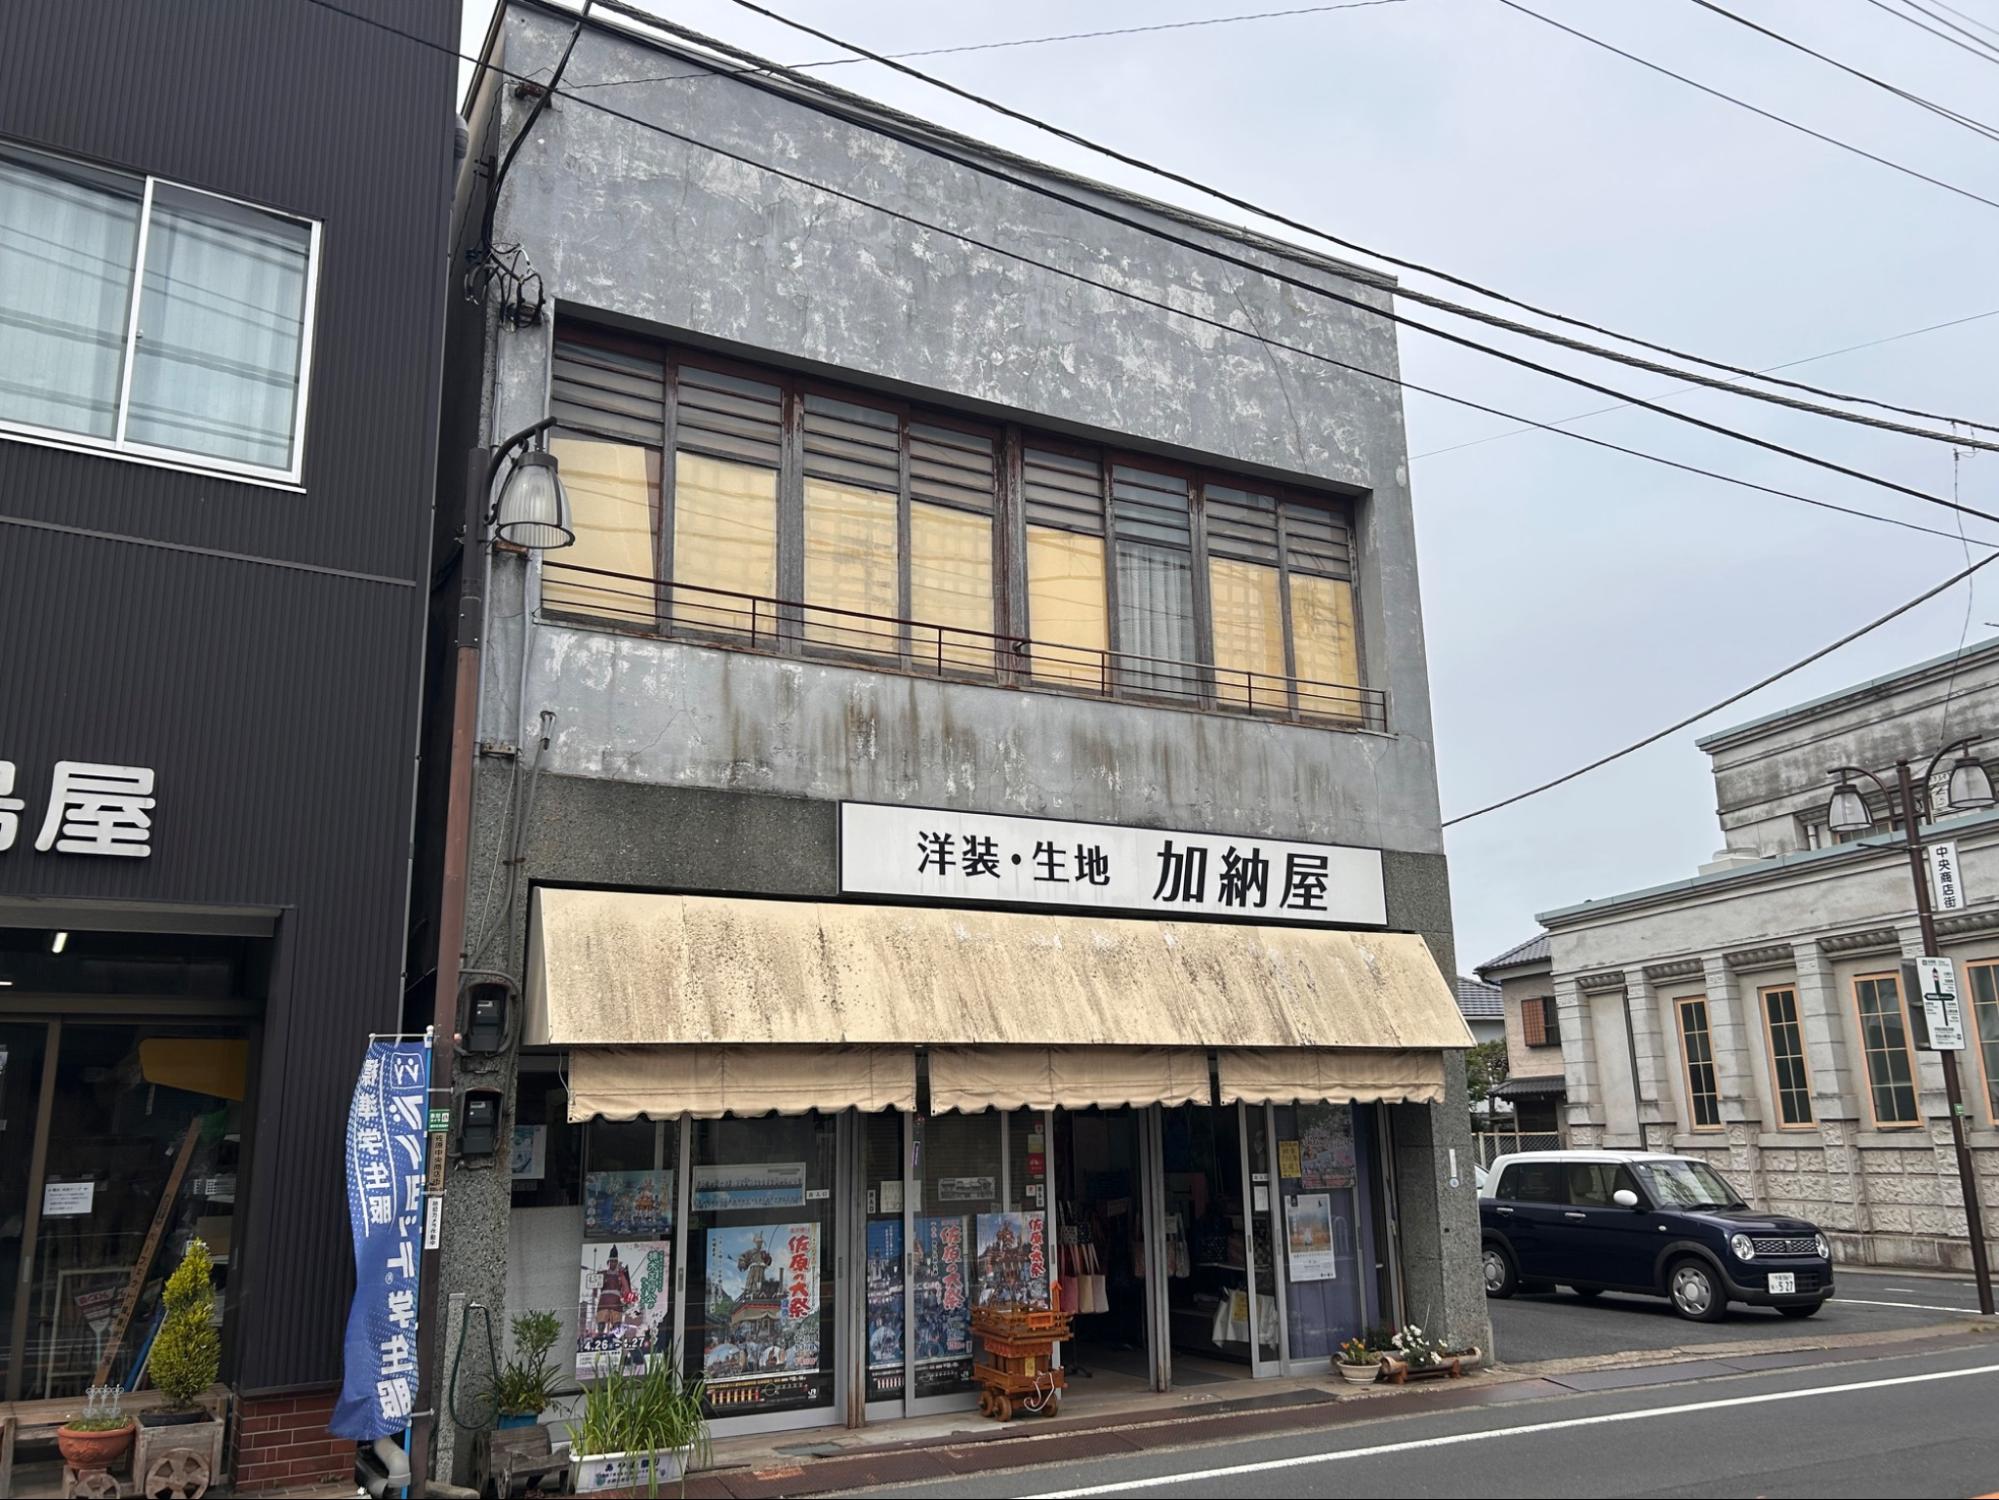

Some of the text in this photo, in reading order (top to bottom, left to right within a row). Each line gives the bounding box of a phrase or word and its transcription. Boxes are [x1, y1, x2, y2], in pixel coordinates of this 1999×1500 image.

[0, 760, 156, 858] 屋
[916, 830, 1330, 913] 洋装・生地 加納屋
[1935, 845, 1957, 909] 中央商店街
[787, 1234, 812, 1319] 佐原の大祭
[940, 1225, 965, 1311] 佐原の大祭
[1029, 1218, 1047, 1279] 佐原の大祭
[584, 1339, 608, 1351] 4.26
